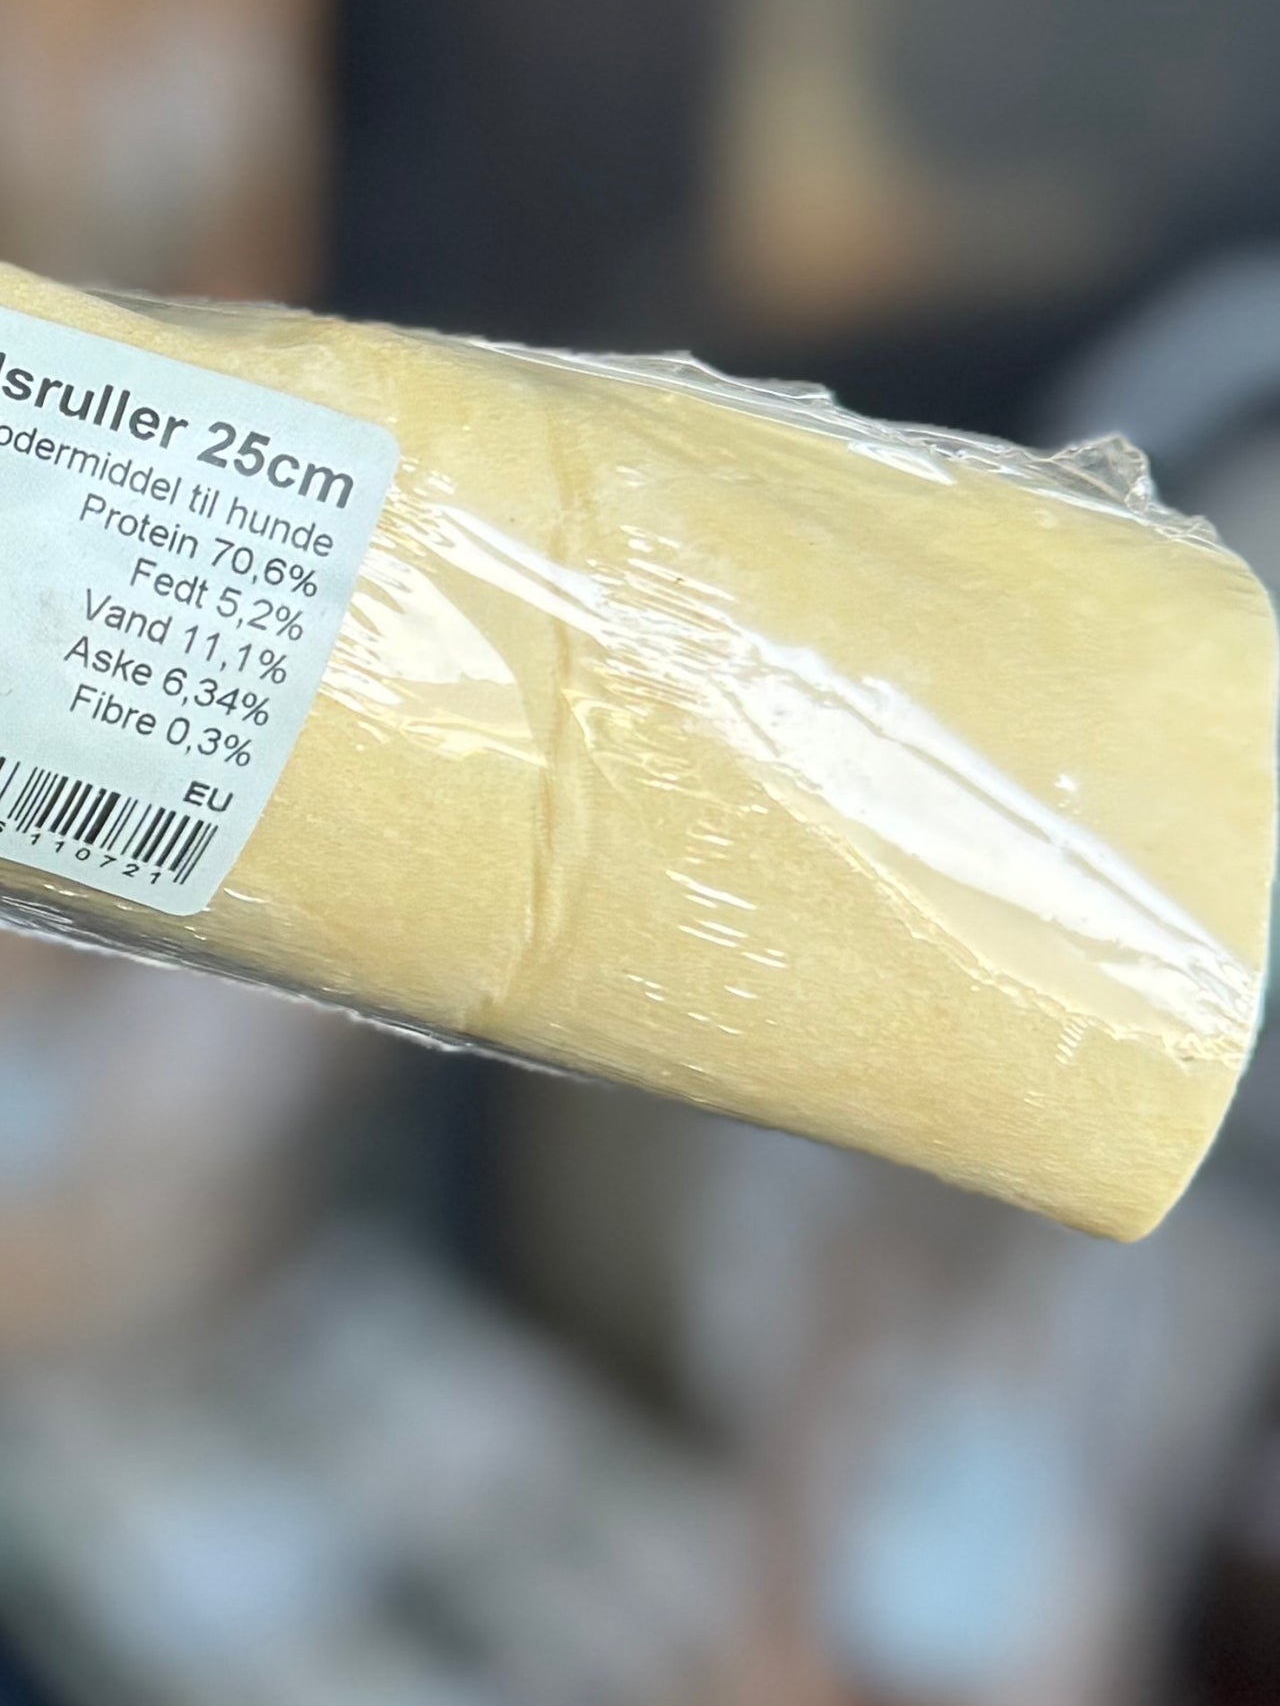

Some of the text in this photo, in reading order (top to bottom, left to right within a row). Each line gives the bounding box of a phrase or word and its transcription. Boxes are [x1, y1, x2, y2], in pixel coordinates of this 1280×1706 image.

[196, 421, 354, 509] 25cm
[80, 493, 318, 597] Protein 70,6%
[187, 483, 220, 520] til
[226, 497, 335, 558] hunde
[86, 588, 287, 685] Vand 11,1%
[129, 557, 303, 642] Fedt 5,2%
[63, 636, 270, 726] Aske 6,34%
[69, 683, 252, 767] Fibre 0,3%
[183, 780, 234, 813] EU
